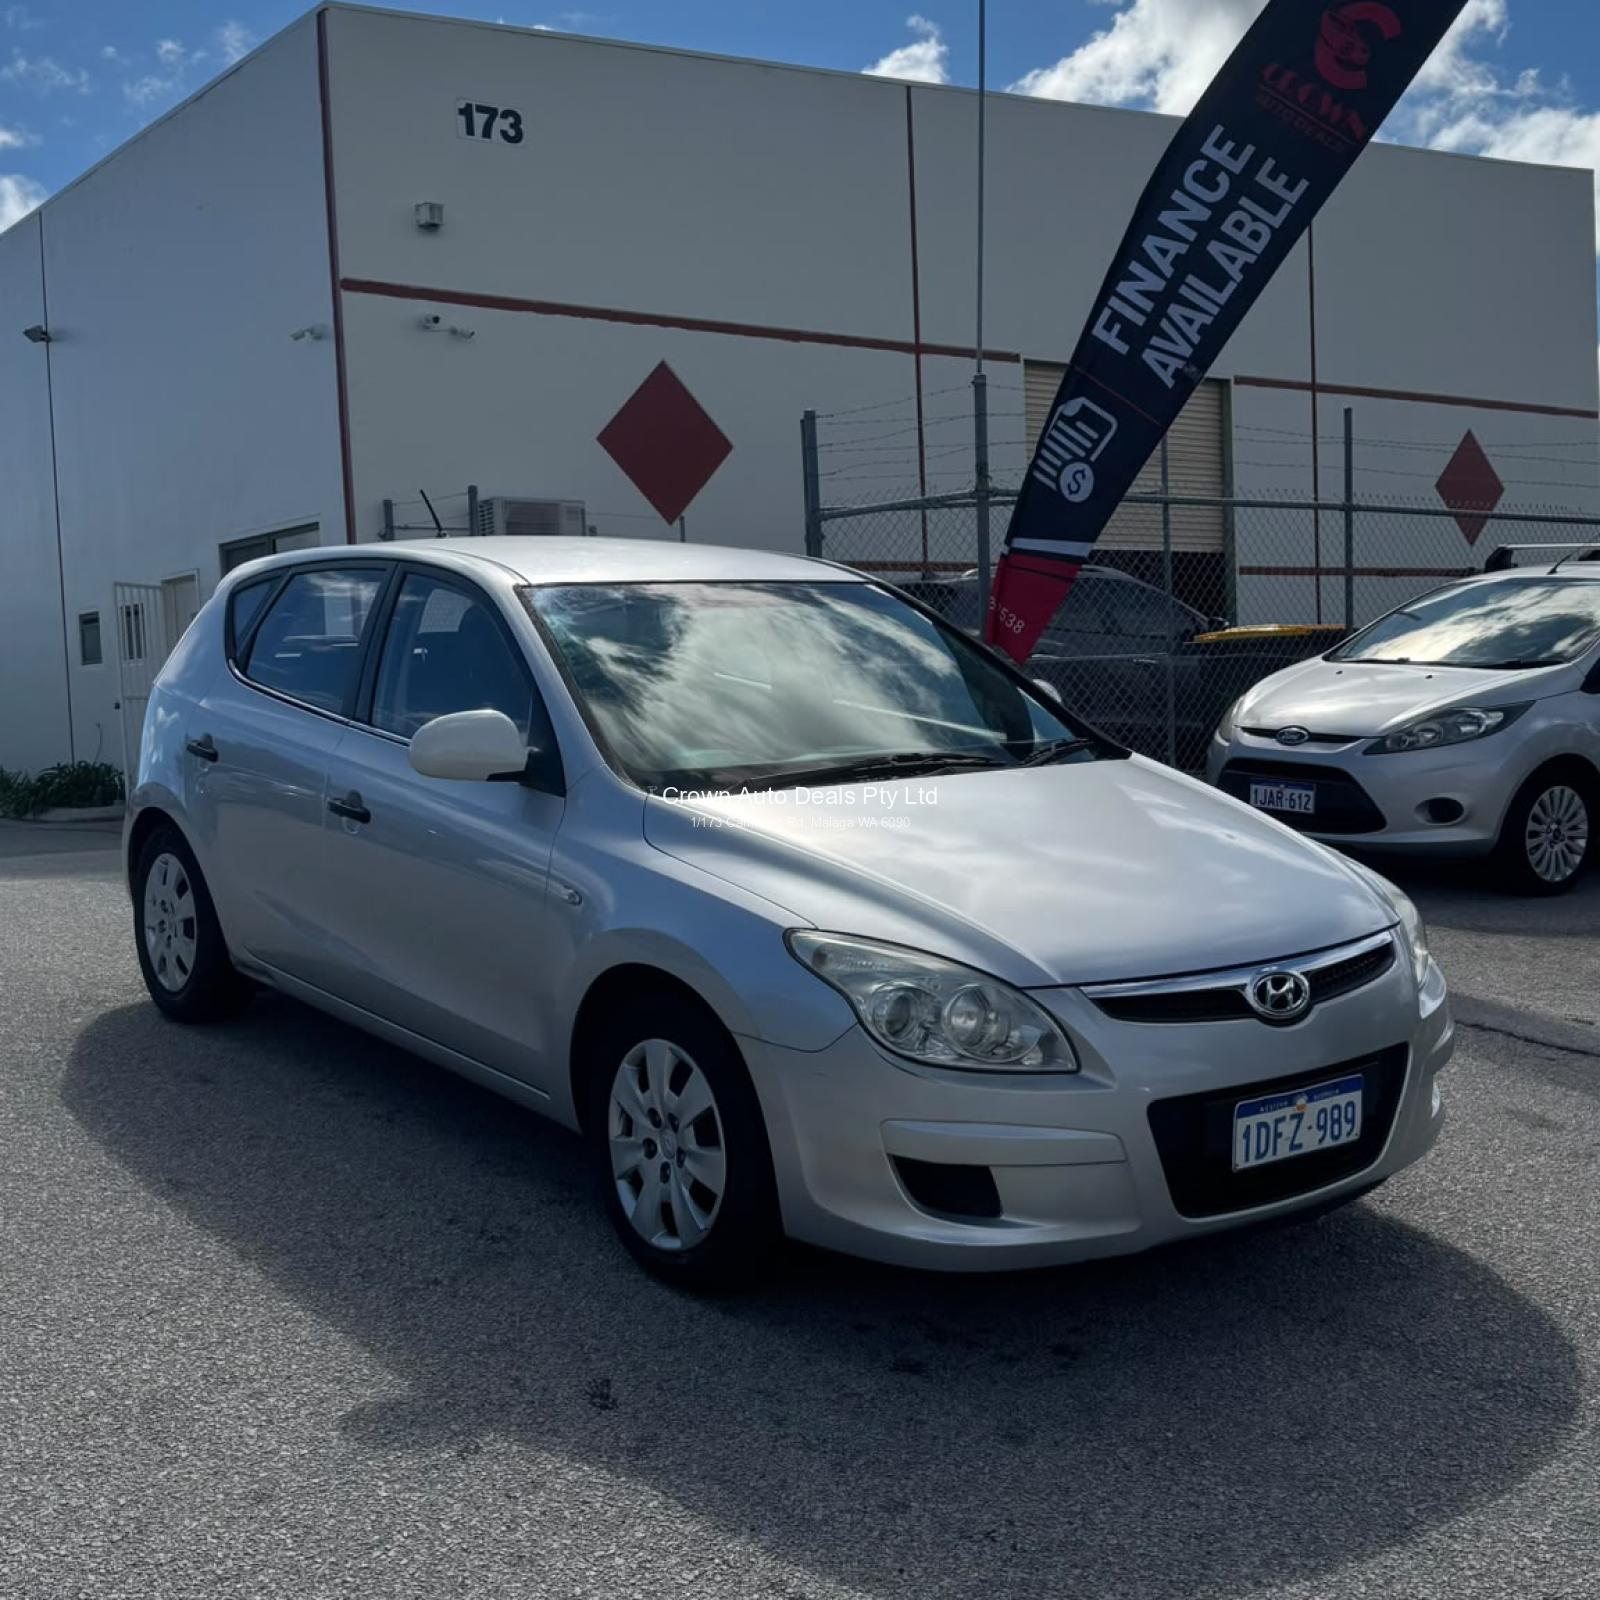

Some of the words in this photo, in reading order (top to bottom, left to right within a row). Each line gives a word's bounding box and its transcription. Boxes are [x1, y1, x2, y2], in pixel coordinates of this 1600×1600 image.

[458, 102, 524, 144] 173
[1092, 124, 1256, 356] FINANCE
[1140, 157, 1310, 389] AVAILABLE
